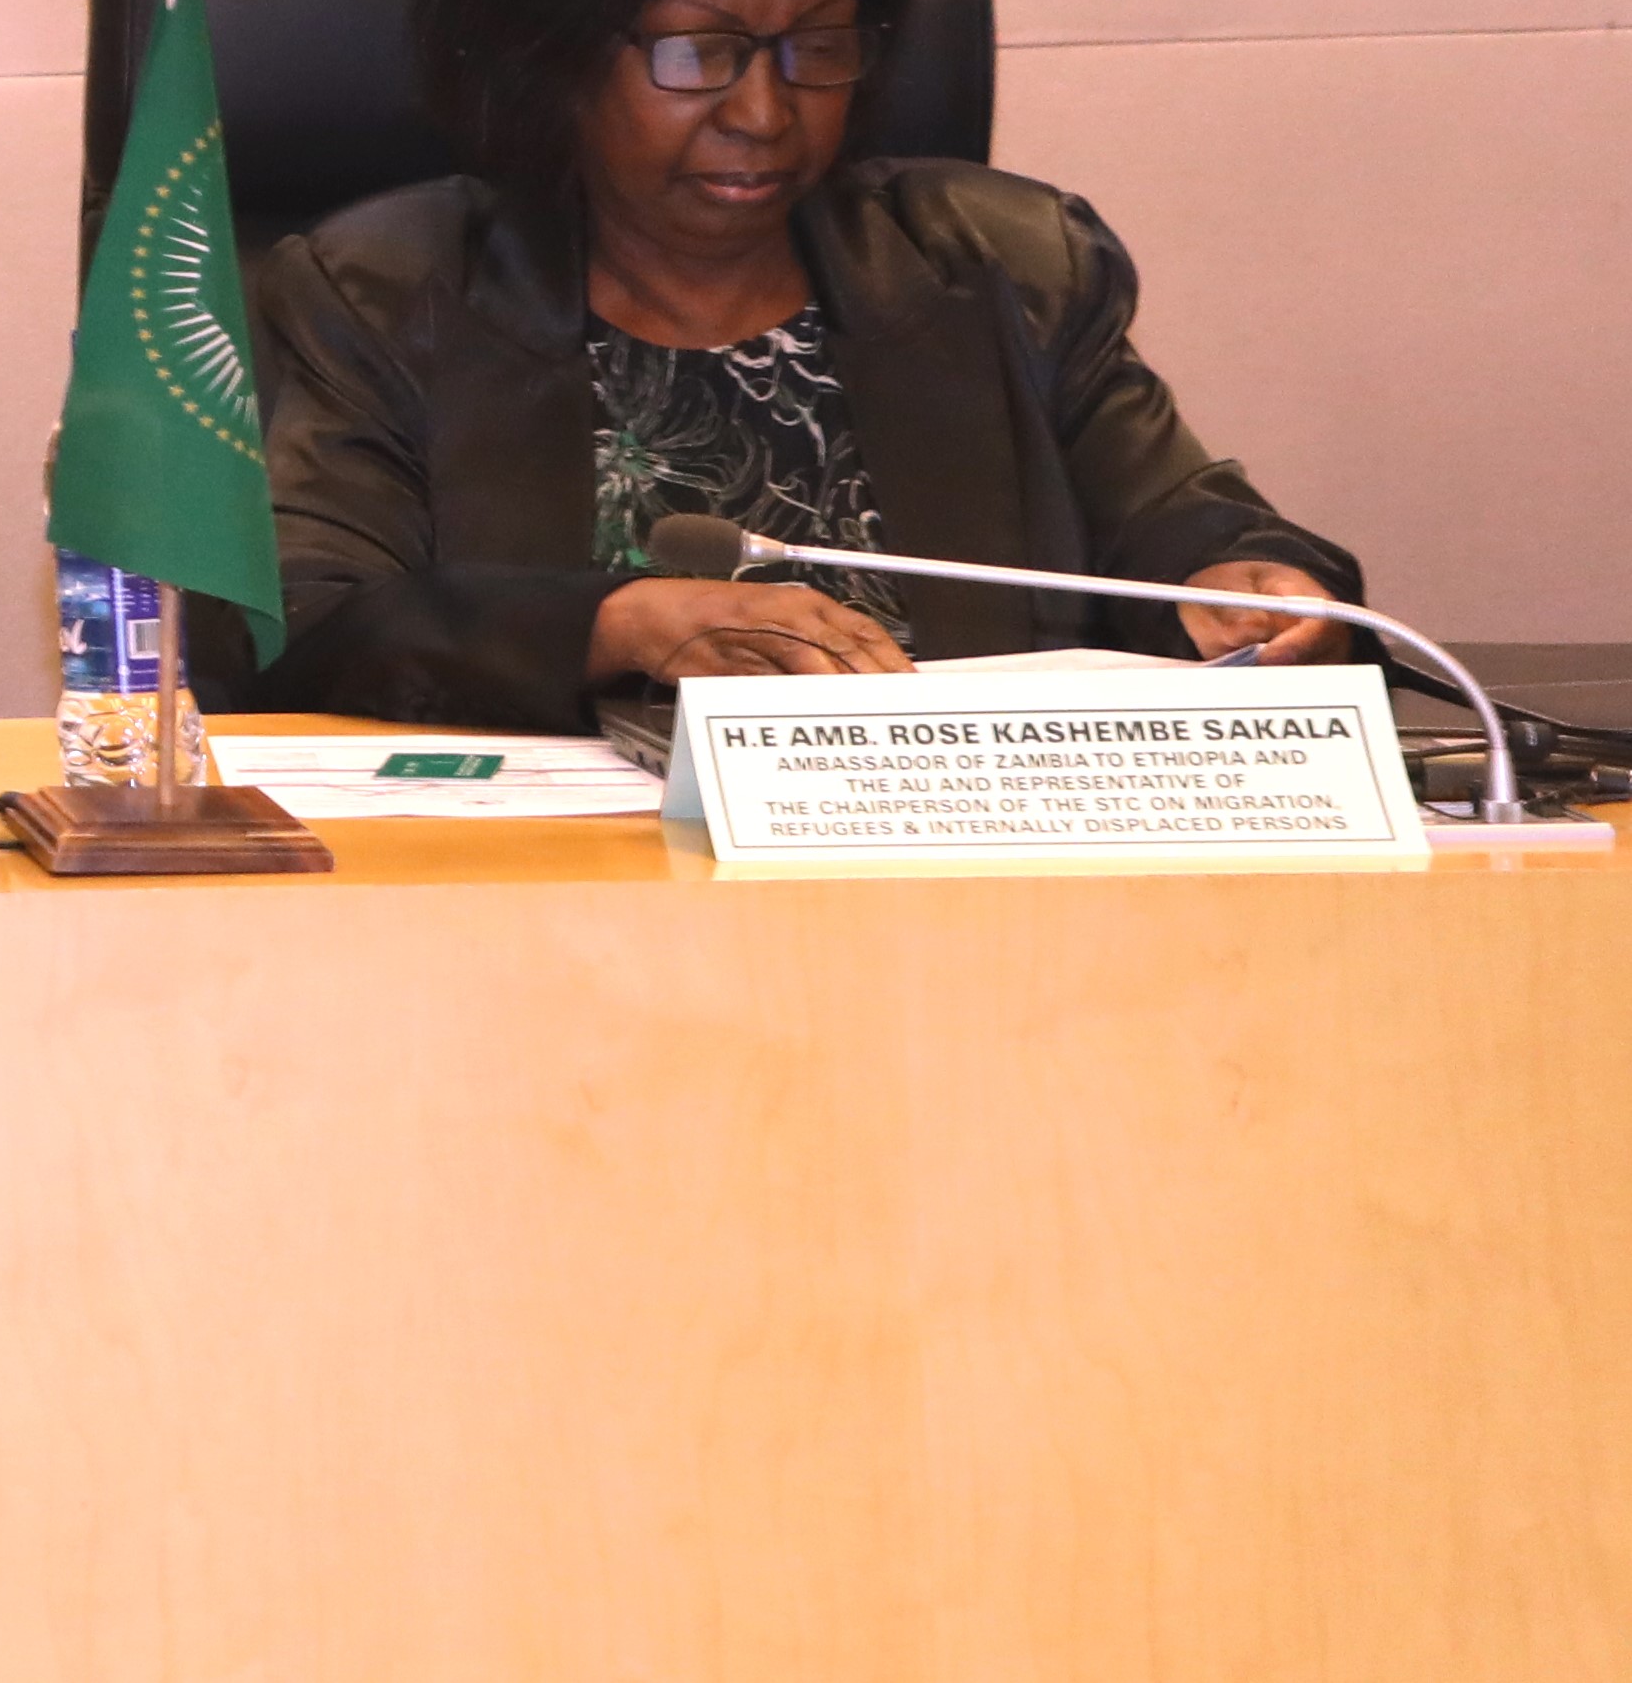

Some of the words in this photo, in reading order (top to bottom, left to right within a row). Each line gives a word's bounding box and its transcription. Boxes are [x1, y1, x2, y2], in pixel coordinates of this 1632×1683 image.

[724, 727, 777, 747] H.E
[791, 726, 877, 746] AMB.
[889, 724, 980, 745] ROSE
[992, 720, 1190, 743] KASHEMBE
[1203, 718, 1351, 740] SAKALA
[778, 755, 947, 771] AMBASSADOR
[956, 755, 985, 769] OF
[994, 753, 1090, 769] ZAMBIA
[1092, 752, 1124, 767] TO
[1133, 751, 1247, 767] ETHIOPIA
[1256, 750, 1307, 765] AND
[845, 778, 890, 792] THE
[900, 778, 930, 792] AU
[940, 777, 991, 791] AND
[1000, 774, 1206, 791] REPRESENTATIVE
[1215, 774, 1245, 788] OF
[765, 801, 810, 815] THE
[819, 799, 990, 814] CHAIRPERSON
[999, 799, 1028, 812] OF
[1040, 798, 1086, 812] THE
[1095, 797, 1141, 811] STC
[1150, 797, 1185, 810] ON
[771, 821, 893, 836] REFUGEES
[904, 821, 920, 834] &
[929, 820, 1072, 834] INTERNALLY
[1085, 817, 1222, 832] DISPLACED
[1231, 816, 1347, 830] PERSONS
